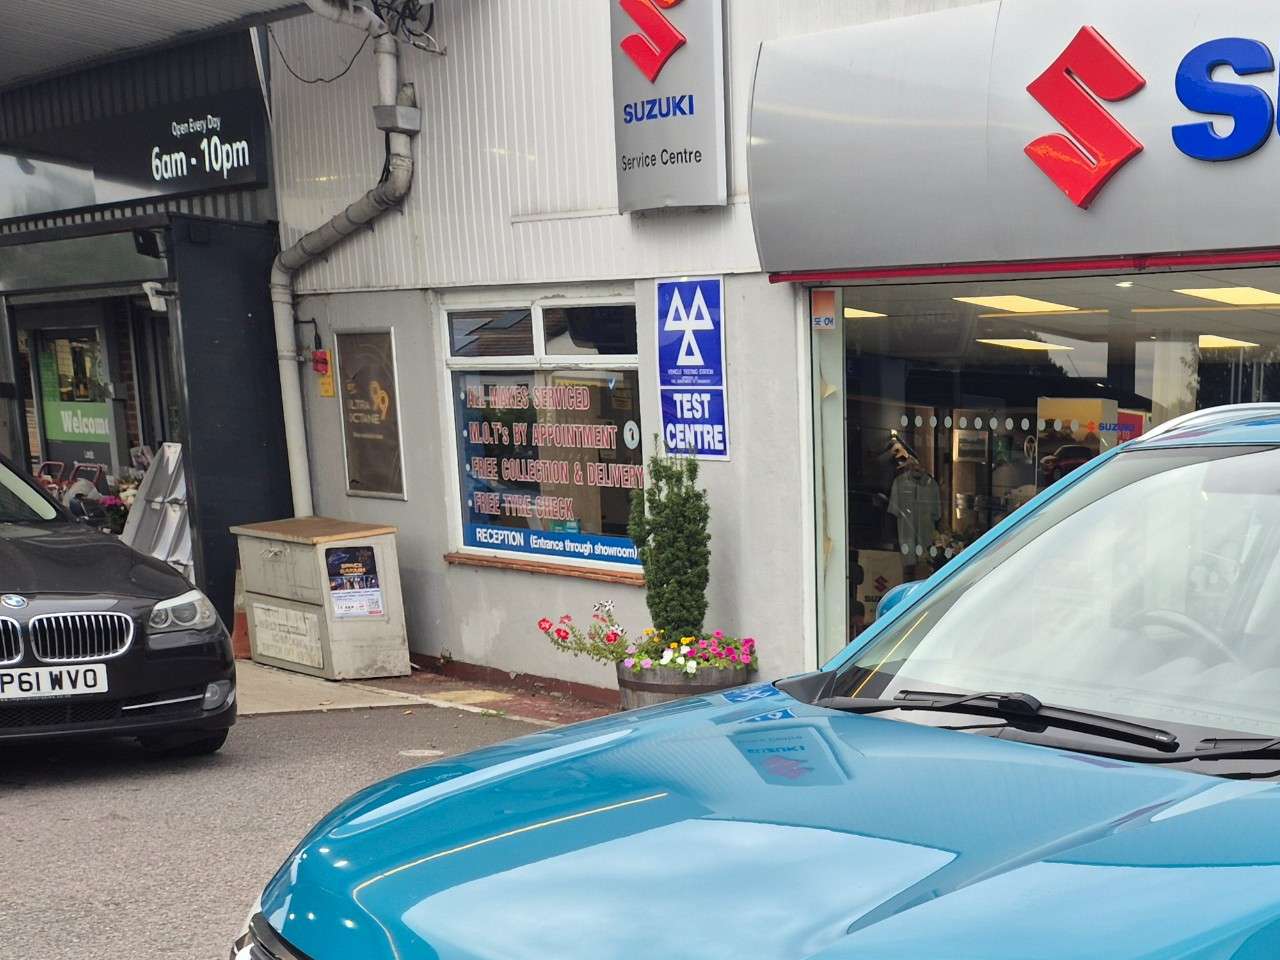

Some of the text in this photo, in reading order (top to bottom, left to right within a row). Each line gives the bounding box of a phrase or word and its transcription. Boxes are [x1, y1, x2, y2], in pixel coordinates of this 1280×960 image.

[623, 94, 695, 124] SUZUKI
[171, 114, 221, 138] Open Every Day
[151, 146, 188, 180] 6am
[200, 135, 249, 179] 10pm
[622, 148, 703, 171] Service Centre
[467, 386, 591, 411] ALL MAKES SERVICED
[673, 392, 711, 419] TEST
[469, 421, 617, 449] M.O.T's BY APPOINTMENT
[666, 423, 724, 450] CENTRE
[471, 457, 645, 489] FREE COLLECTION & DELIVERY
[474, 491, 575, 521] FREE TYRE CHECK
[476, 527, 638, 561] RECEPTION (Entrance through showroom)
[0, 669, 98, 693] P61 WVO
